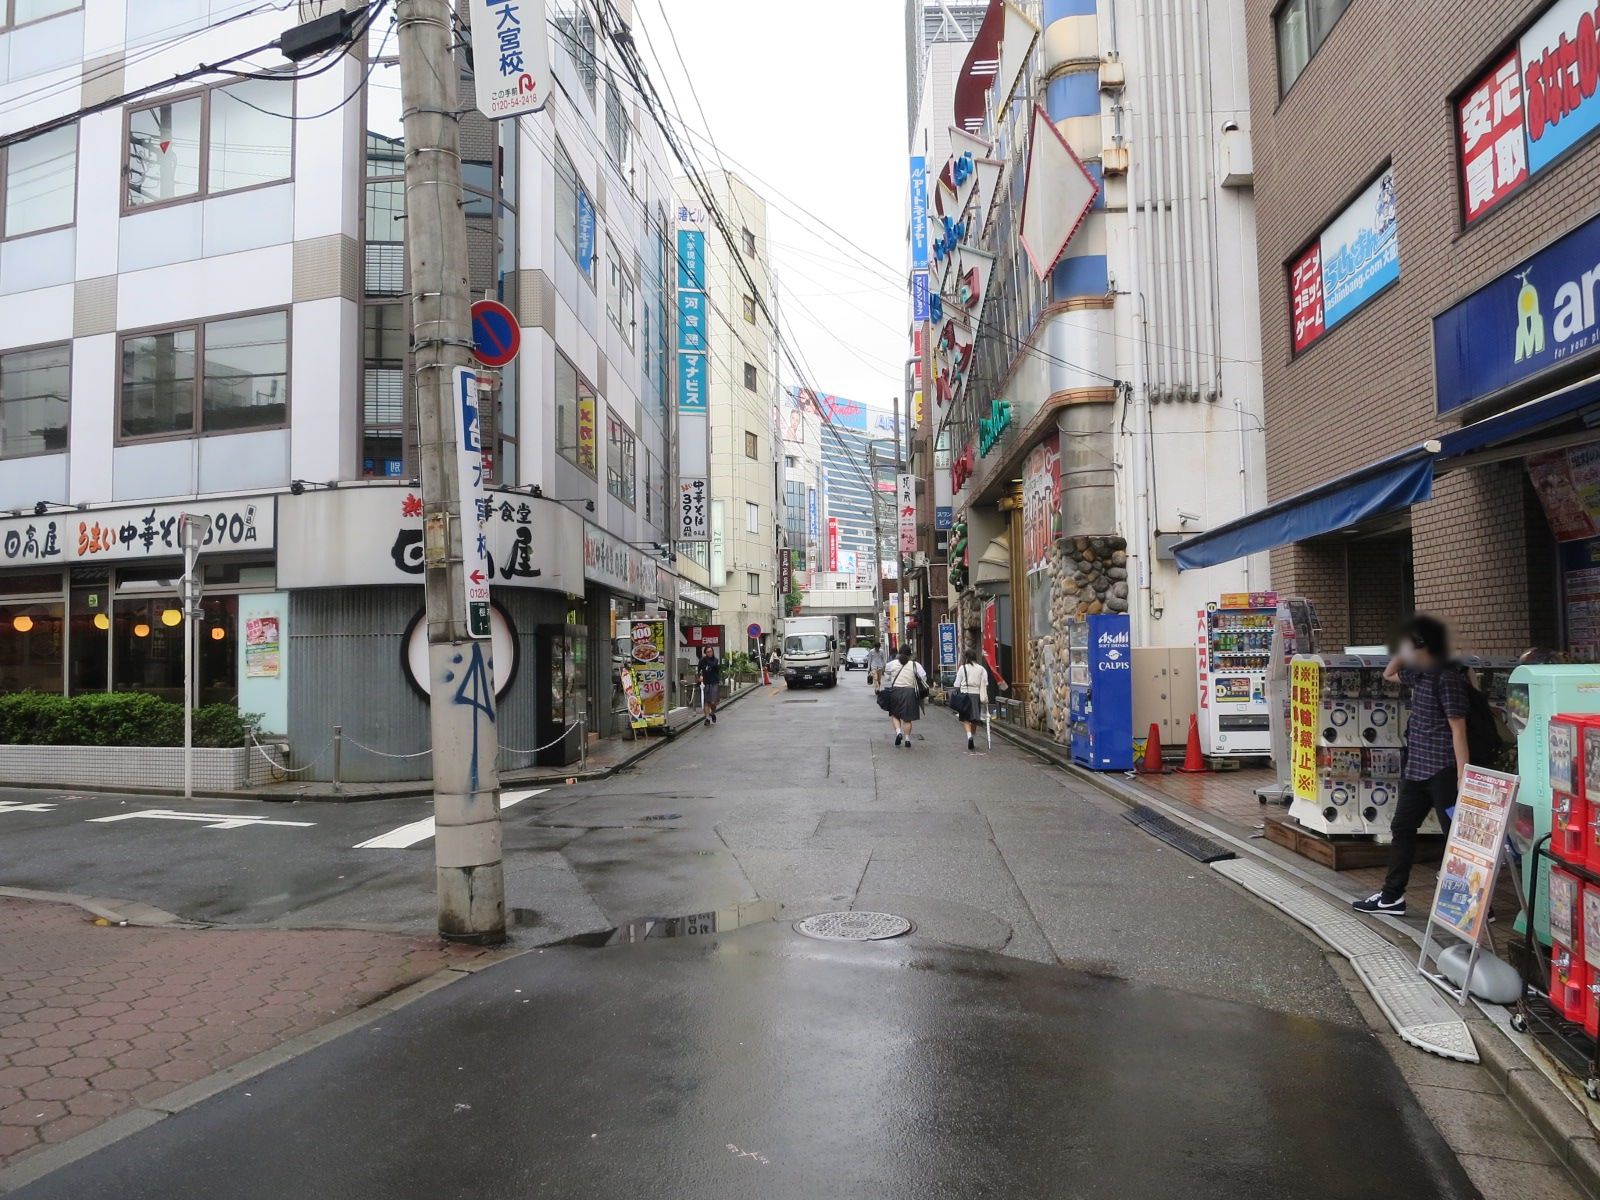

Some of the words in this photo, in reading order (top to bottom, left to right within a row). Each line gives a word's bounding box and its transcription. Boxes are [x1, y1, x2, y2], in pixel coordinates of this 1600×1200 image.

[495, 4, 525, 77] 大宮校
[1525, 8, 1600, 142] あなたの
[492, 94, 538, 112] 0120-54-2418
[1462, 58, 1520, 154] 安心
[1466, 124, 1526, 214] 買取
[1294, 248, 1320, 291] アニメ
[1326, 262, 1383, 312] lashinbang.com
[685, 296, 699, 346] 河合塾
[1296, 303, 1323, 341] ゲーム
[1554, 346, 1566, 360] for
[1570, 337, 1588, 354] your
[685, 354, 699, 405] マナビス
[693, 480, 705, 527] 中華そば
[4, 521, 61, 559] 日高屋
[714, 531, 722, 554] ZELE
[942, 631, 954, 663] 美容室
[1098, 631, 1129, 644] Asahi
[1197, 610, 1208, 709] KIRIN
[1098, 661, 1130, 672] CALPIS
